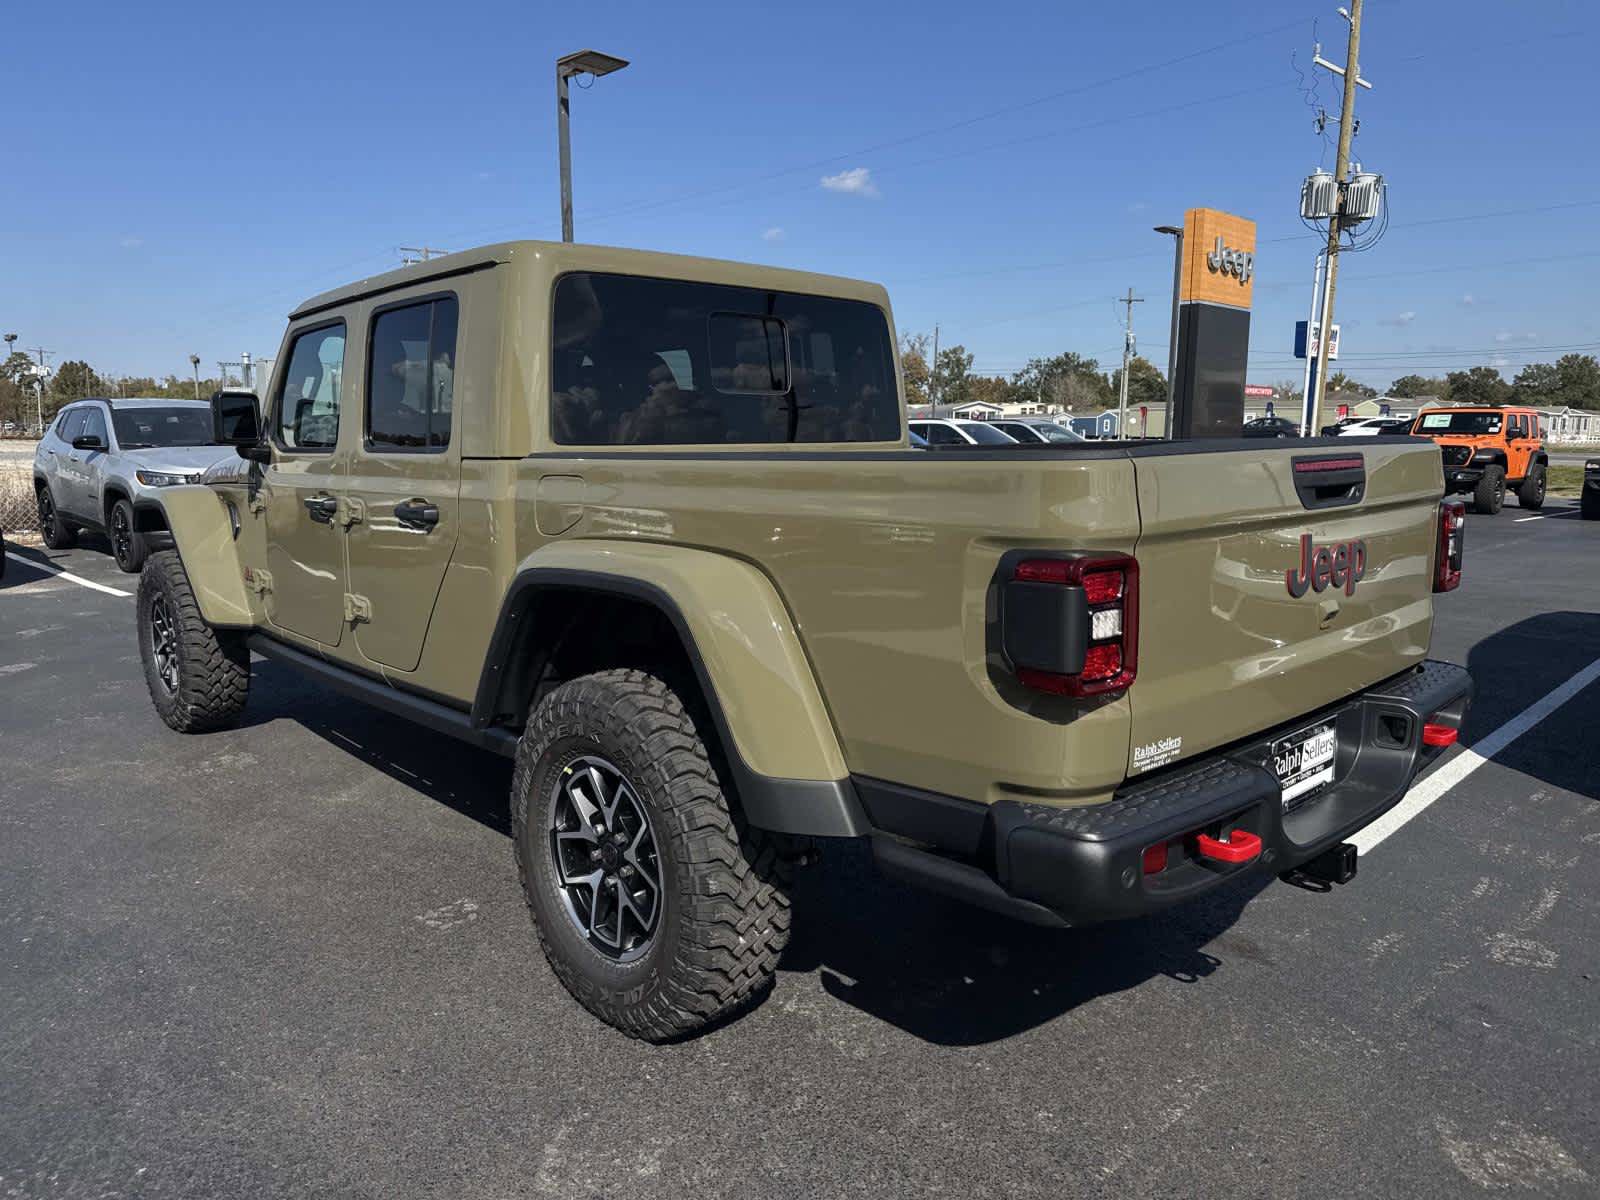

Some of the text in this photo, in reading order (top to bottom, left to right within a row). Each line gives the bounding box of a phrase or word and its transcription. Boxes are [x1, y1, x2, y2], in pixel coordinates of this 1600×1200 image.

[1207, 236, 1254, 283] Jeep
[1287, 533, 1367, 598] Jeep
[1134, 744, 1157, 760] Ralph
[1158, 736, 1182, 750] Sellers
[1274, 747, 1301, 775] Ralph
[1303, 737, 1334, 762] Sellers
